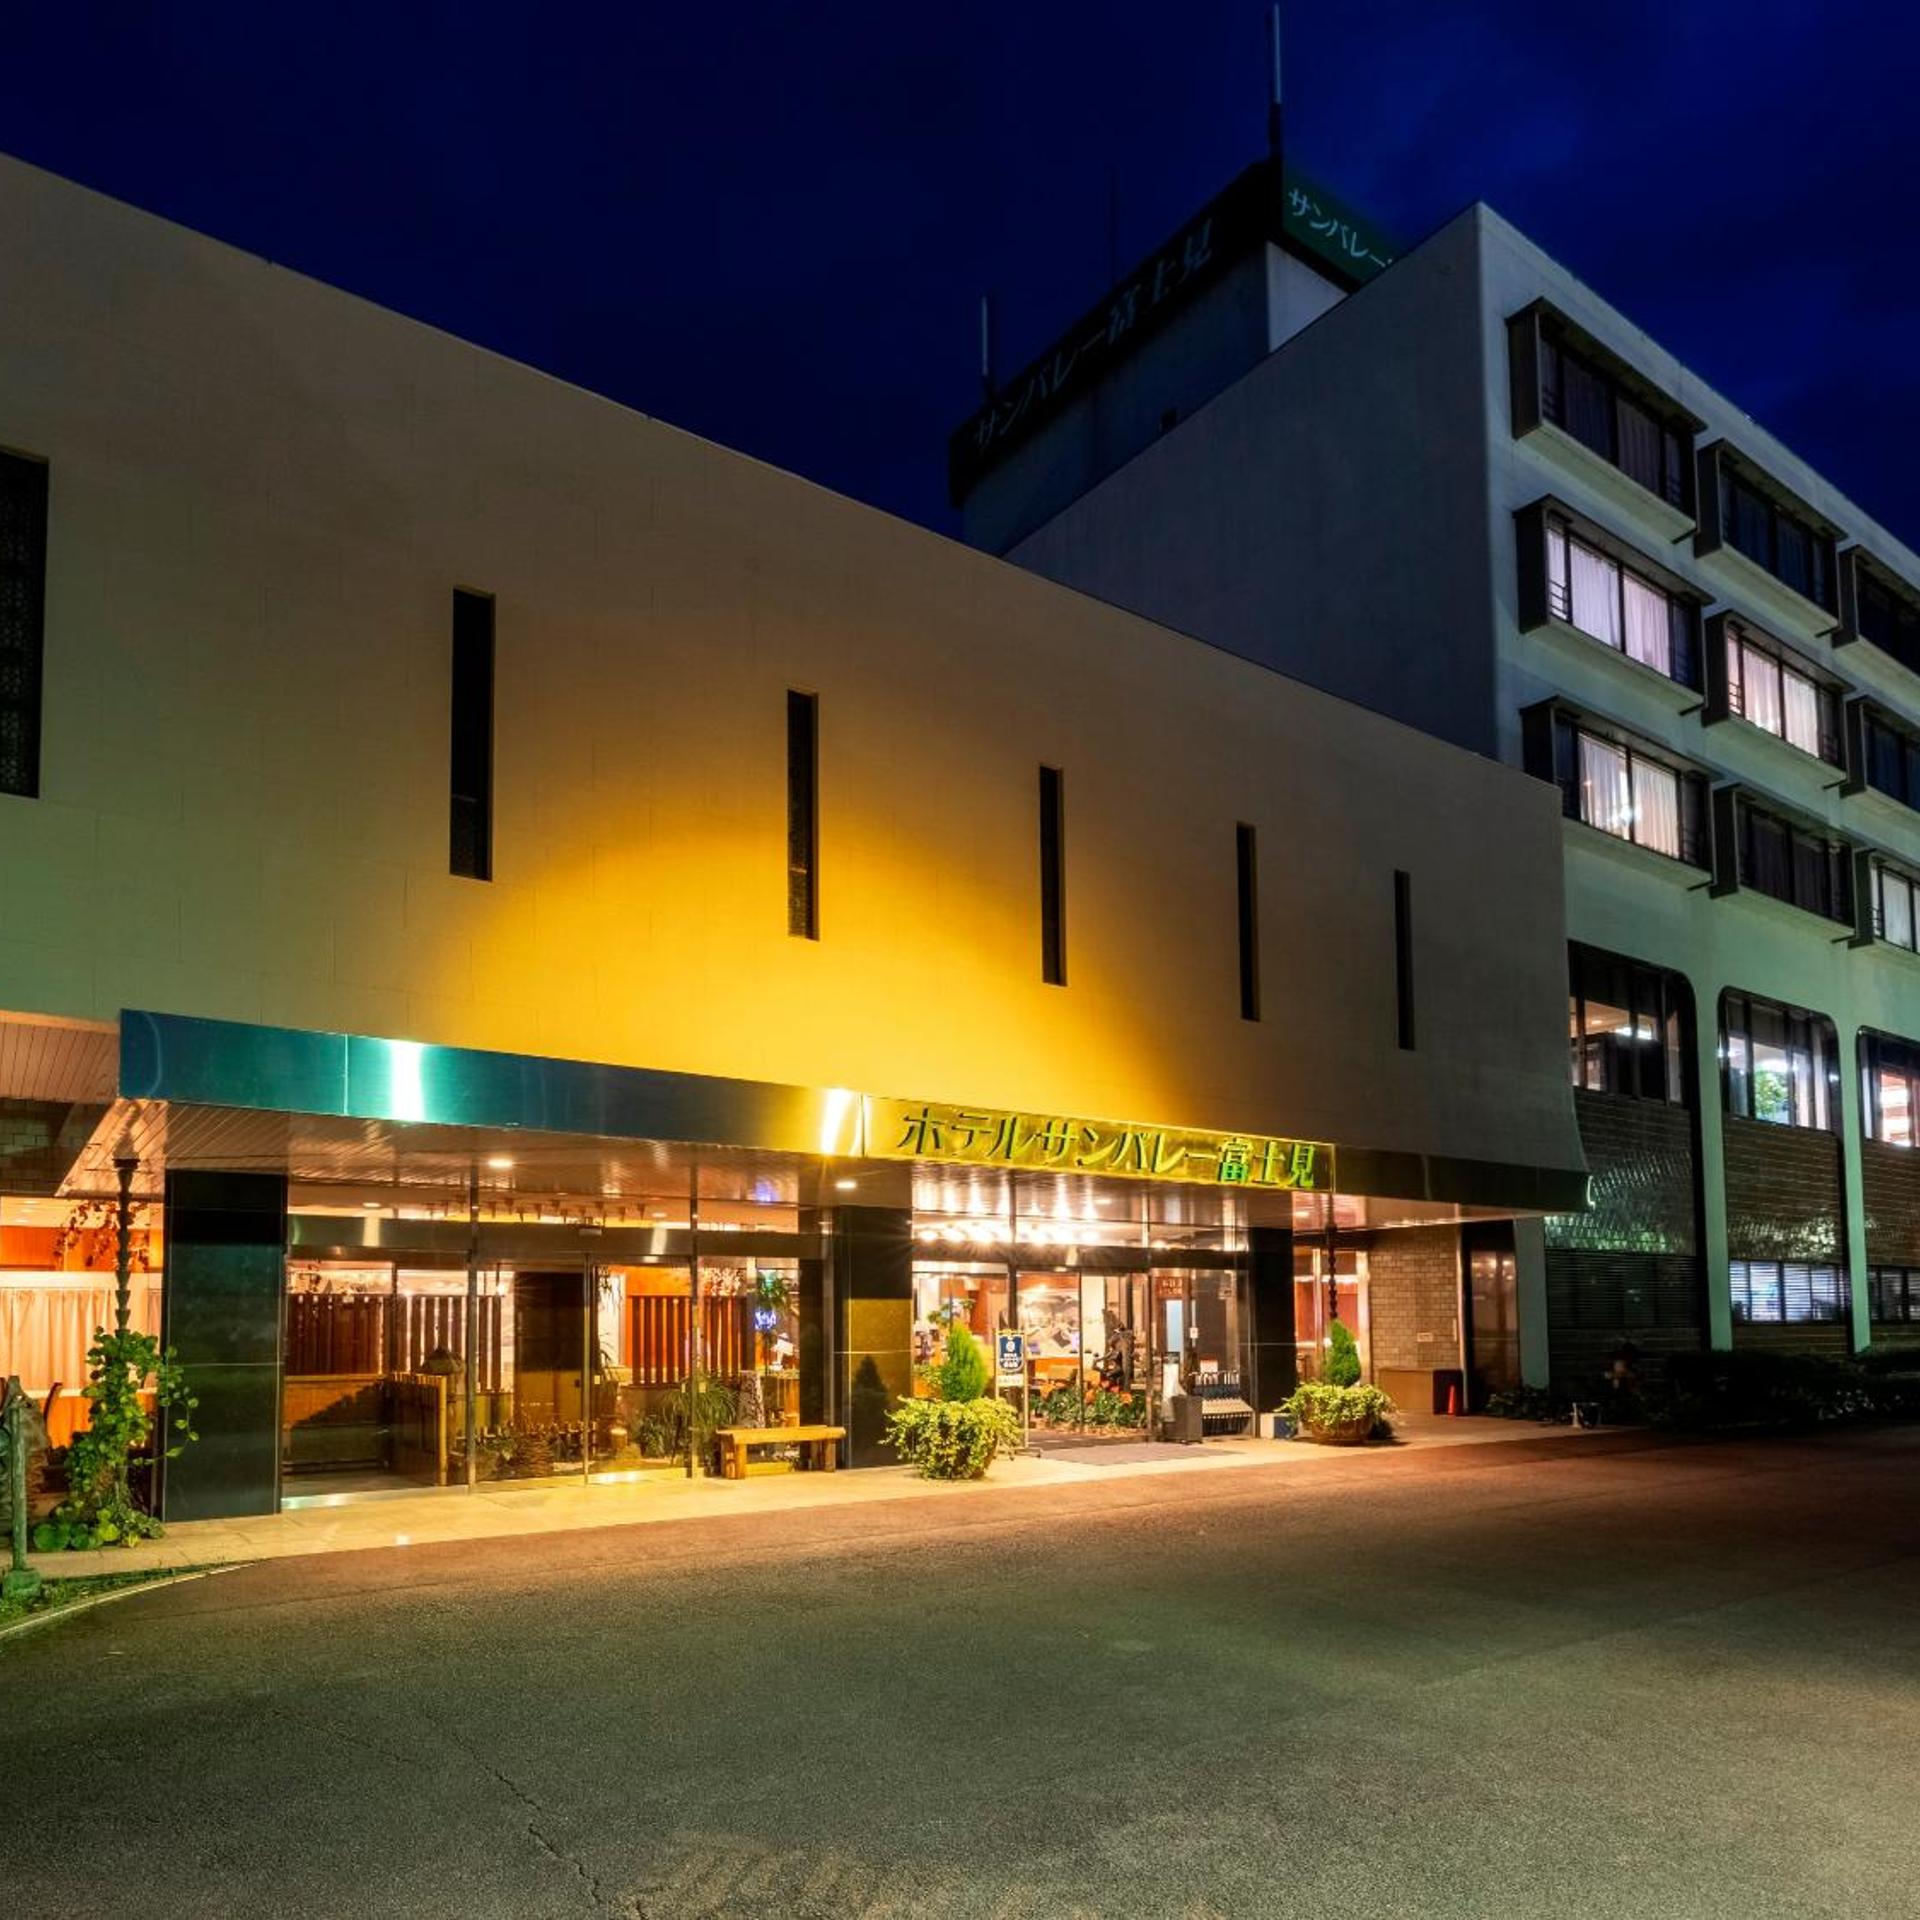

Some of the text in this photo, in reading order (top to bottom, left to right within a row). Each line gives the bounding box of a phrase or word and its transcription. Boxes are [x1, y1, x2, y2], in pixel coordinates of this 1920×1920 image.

[1287, 188, 1393, 268] サンバレー
[897, 1108, 1317, 1188] ホテルサンバレー富士見
